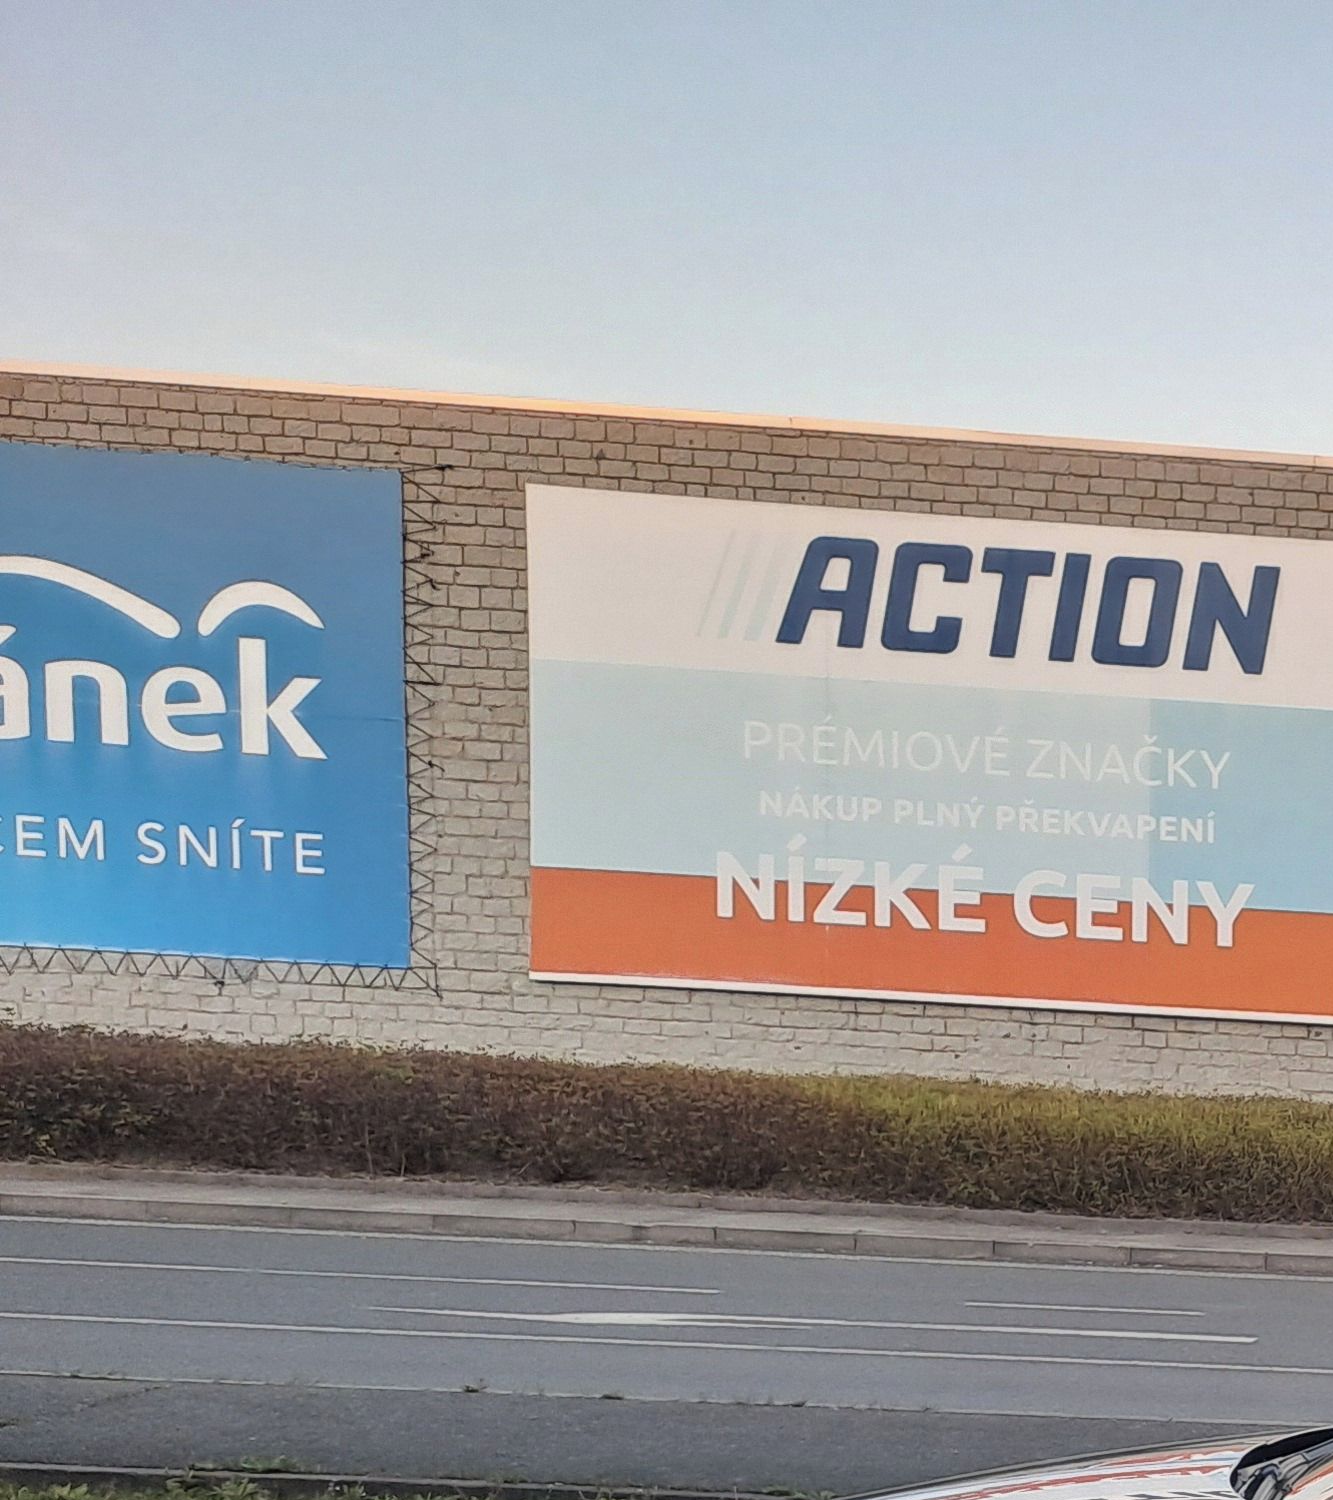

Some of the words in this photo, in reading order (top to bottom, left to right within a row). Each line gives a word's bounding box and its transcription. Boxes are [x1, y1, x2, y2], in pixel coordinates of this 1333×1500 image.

[775, 536, 1281, 675] ACTION
[743, 716, 1012, 778] PRÉMIOVÉ
[1025, 735, 1231, 790] ZNAČKY
[0, 814, 105, 861] EM
[136, 818, 326, 875] SNÍTE
[759, 787, 883, 822] NÁKUP
[893, 796, 985, 830] PLNÝ
[996, 800, 1217, 844] PŘEKVAPENÍ
[715, 833, 986, 934] NÍZKÉ
[1013, 869, 1256, 948] CENY
